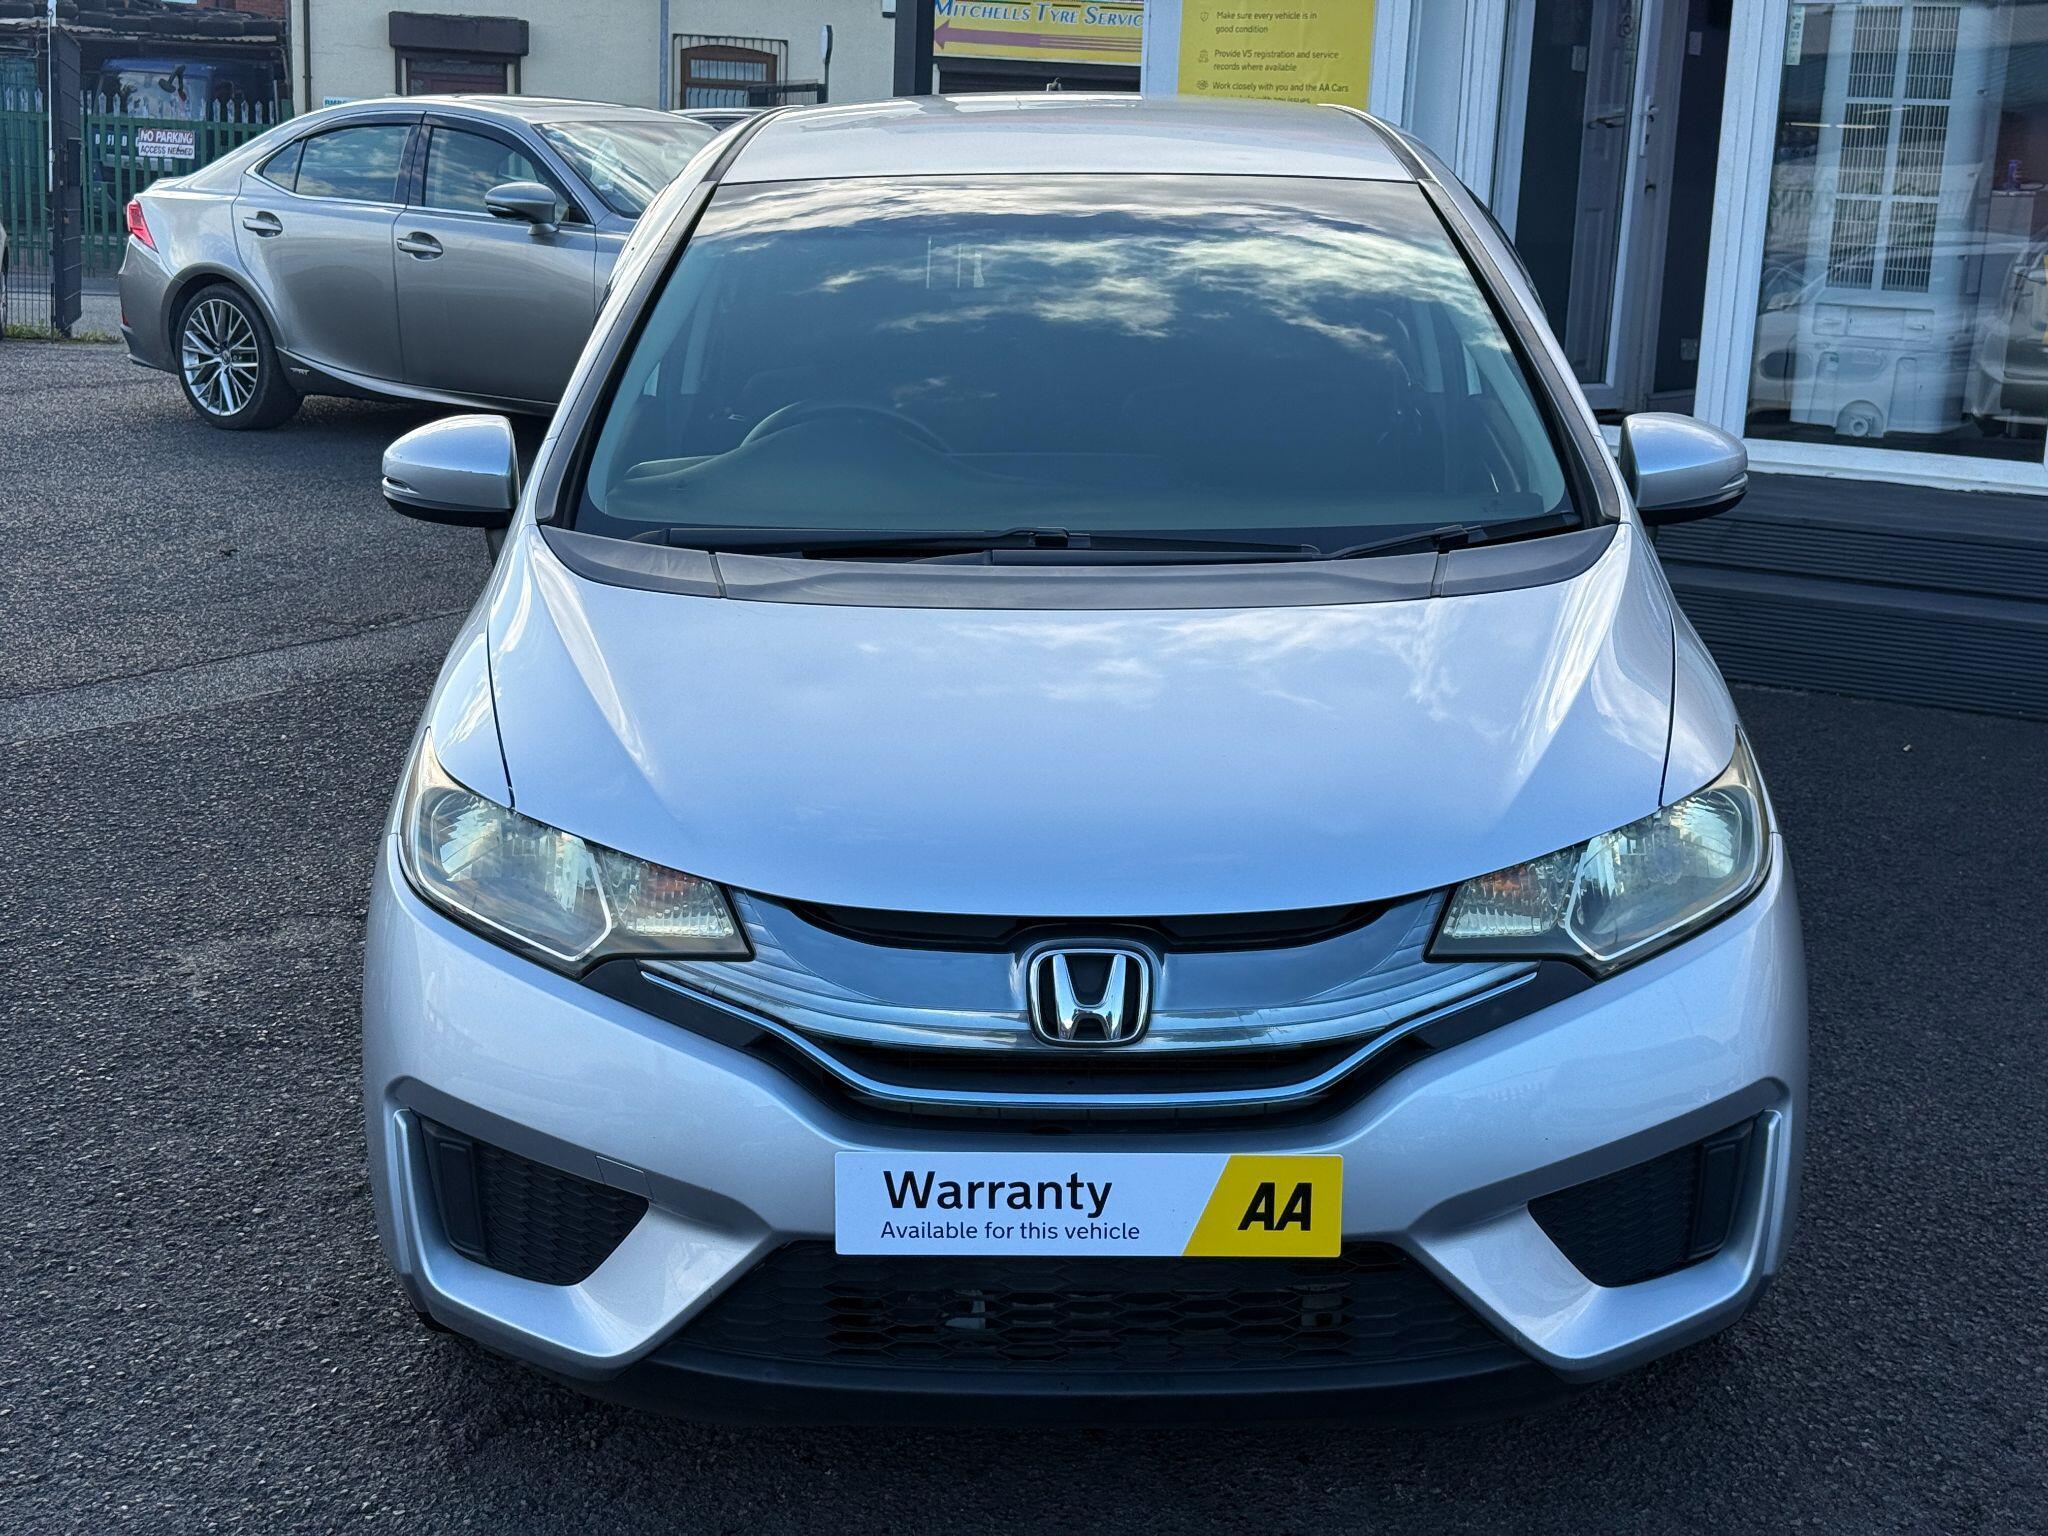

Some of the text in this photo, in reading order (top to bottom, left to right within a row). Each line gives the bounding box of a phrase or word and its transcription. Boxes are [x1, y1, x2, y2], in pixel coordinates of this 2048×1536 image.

[1036, 4, 1078, 23] TYRE
[1217, 11, 1317, 21] Make sure every vehicle is in
[1215, 25, 1268, 34] good condition
[1214, 49, 1241, 58] Provide
[1253, 50, 1295, 60] registration
[1296, 50, 1311, 59] and
[1312, 51, 1339, 59] service
[1213, 62, 1297, 72] records where available
[1212, 81, 1349, 93] Work closely with you and the AA Cars
[140, 130, 154, 142] NO
[156, 130, 193, 144] PARKING
[140, 145, 166, 155] ACCESS
[883, 1170, 1113, 1219] Warranty
[1237, 1182, 1313, 1232] AA
[880, 1221, 1140, 1241] Available for this vehicle
